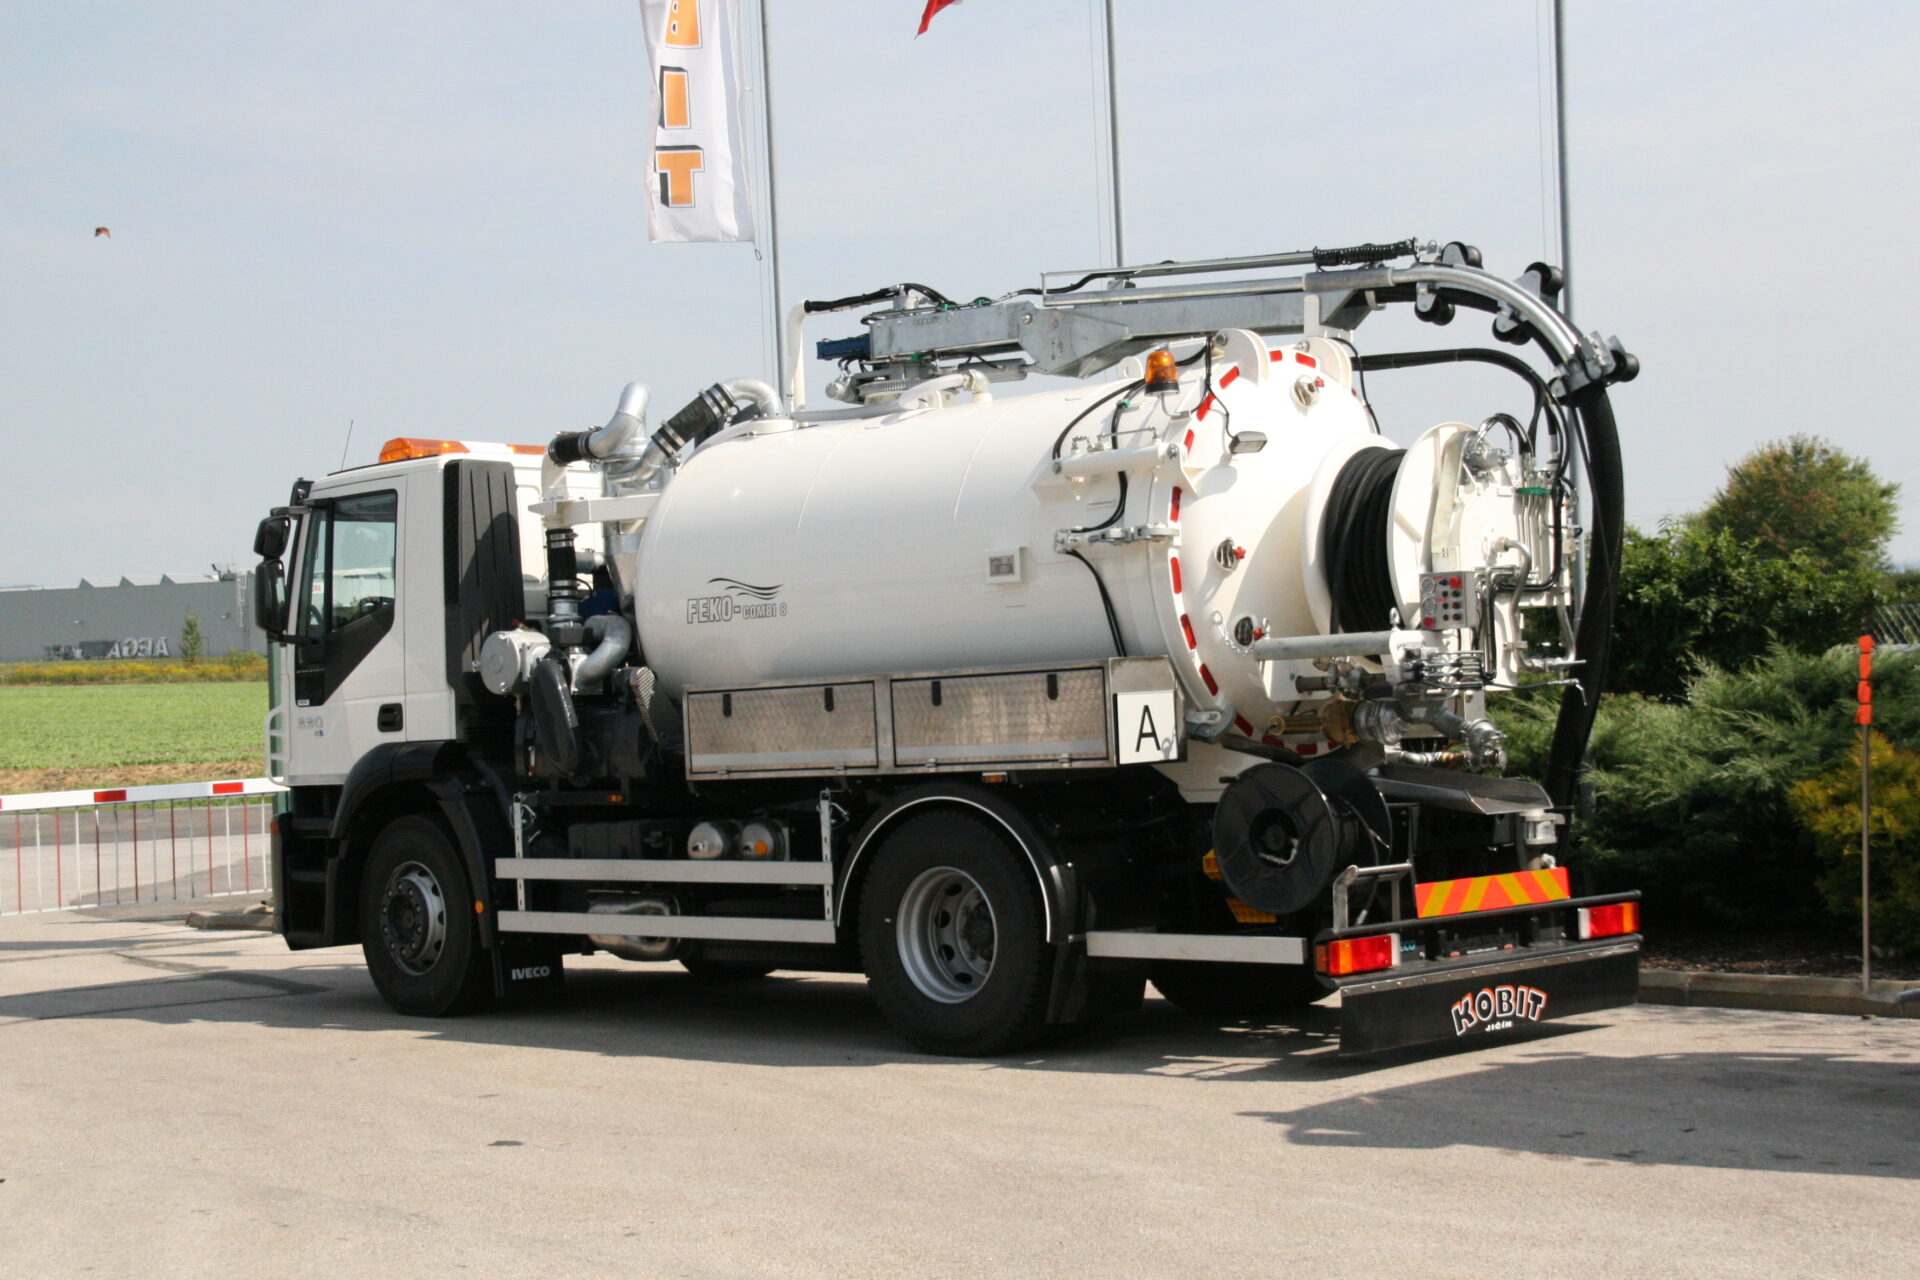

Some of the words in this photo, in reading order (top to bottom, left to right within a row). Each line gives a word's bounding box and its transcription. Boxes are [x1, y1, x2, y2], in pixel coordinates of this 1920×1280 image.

[1135, 704, 1161, 753] A
[511, 966, 550, 980] IVECO
[1451, 984, 1549, 1036] KOBIT
